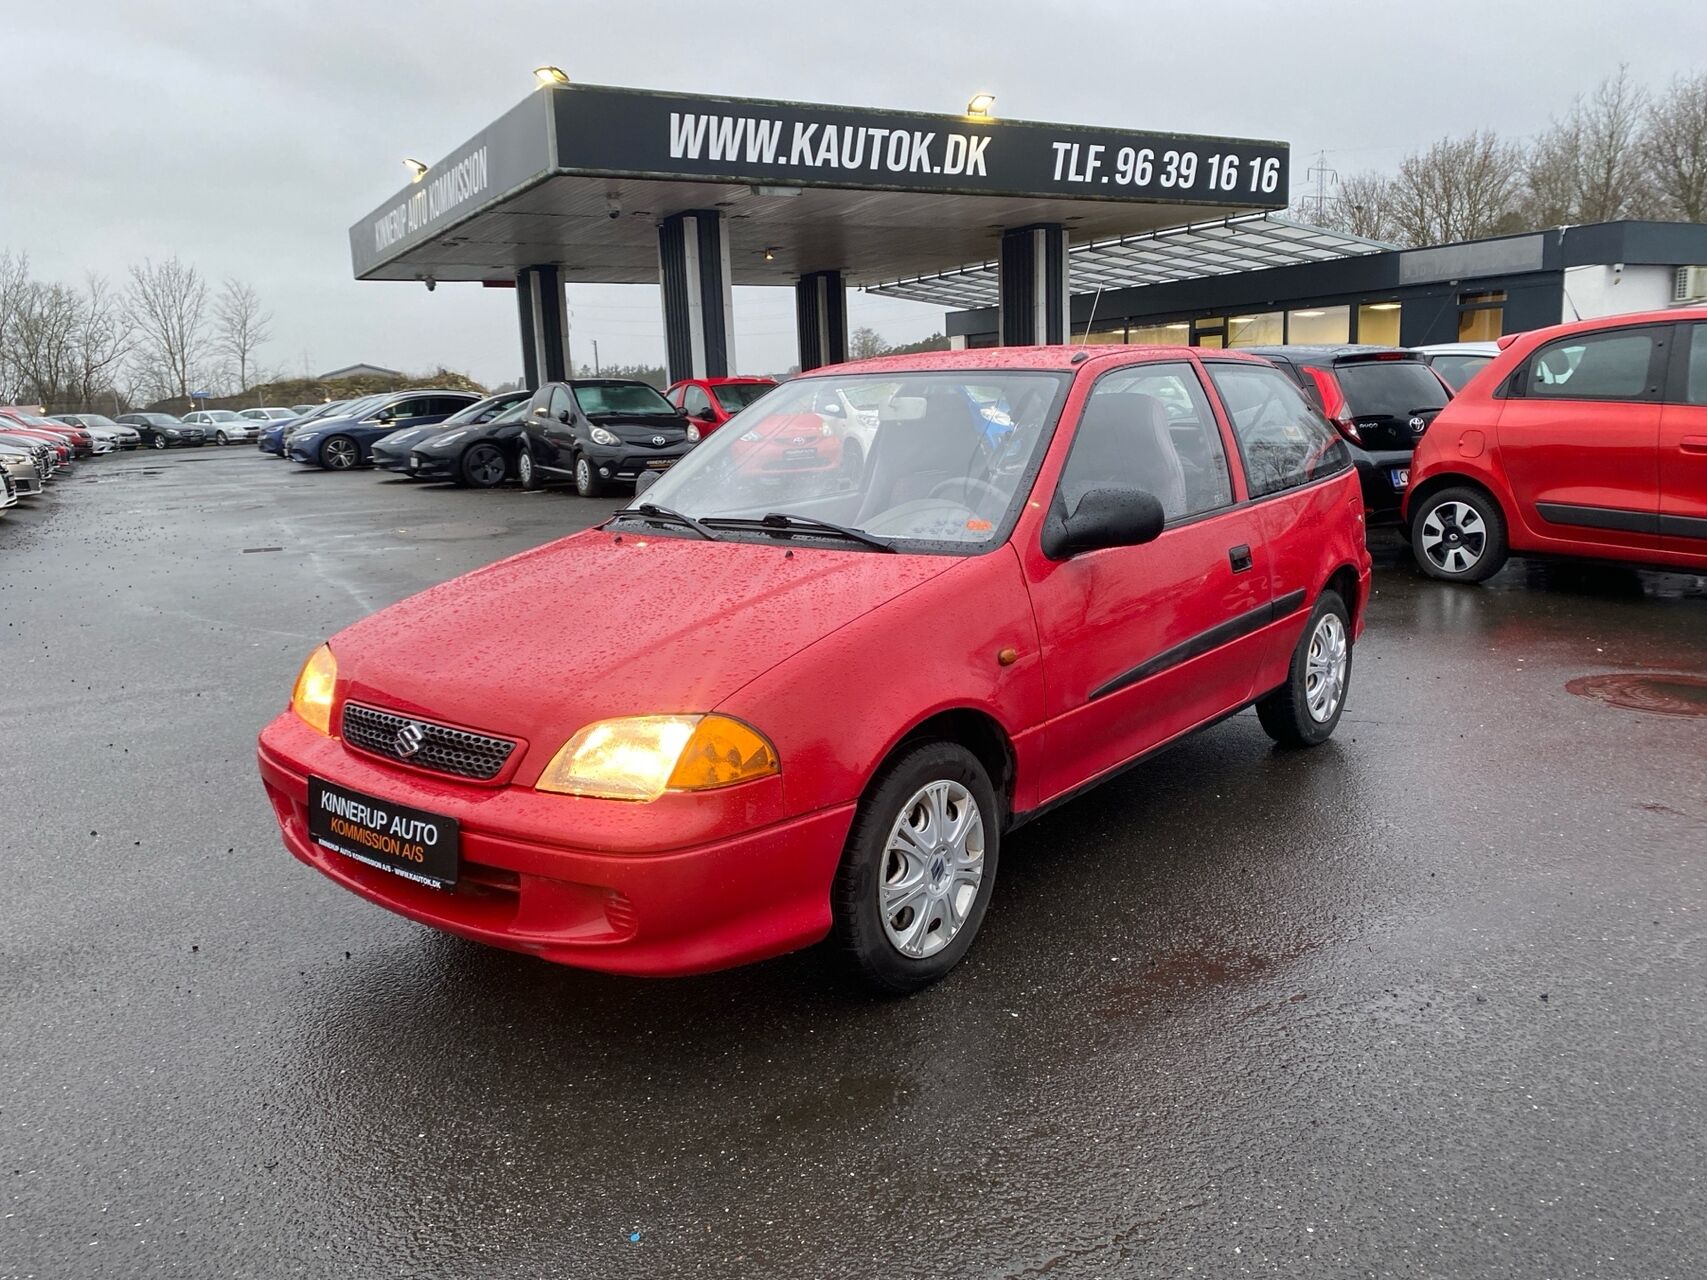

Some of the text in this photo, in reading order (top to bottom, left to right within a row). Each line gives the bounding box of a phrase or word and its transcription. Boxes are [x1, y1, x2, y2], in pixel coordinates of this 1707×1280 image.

[670, 112, 992, 176] WWW.KAUTOK.DK
[1052, 142, 1280, 193] TLF. 96 39 16 16
[408, 188, 428, 234] AUTO
[428, 146, 487, 221] KOMMISSION
[321, 791, 438, 846] KINNERUP AUTO
[330, 817, 424, 863] KOMMISSION A/S
